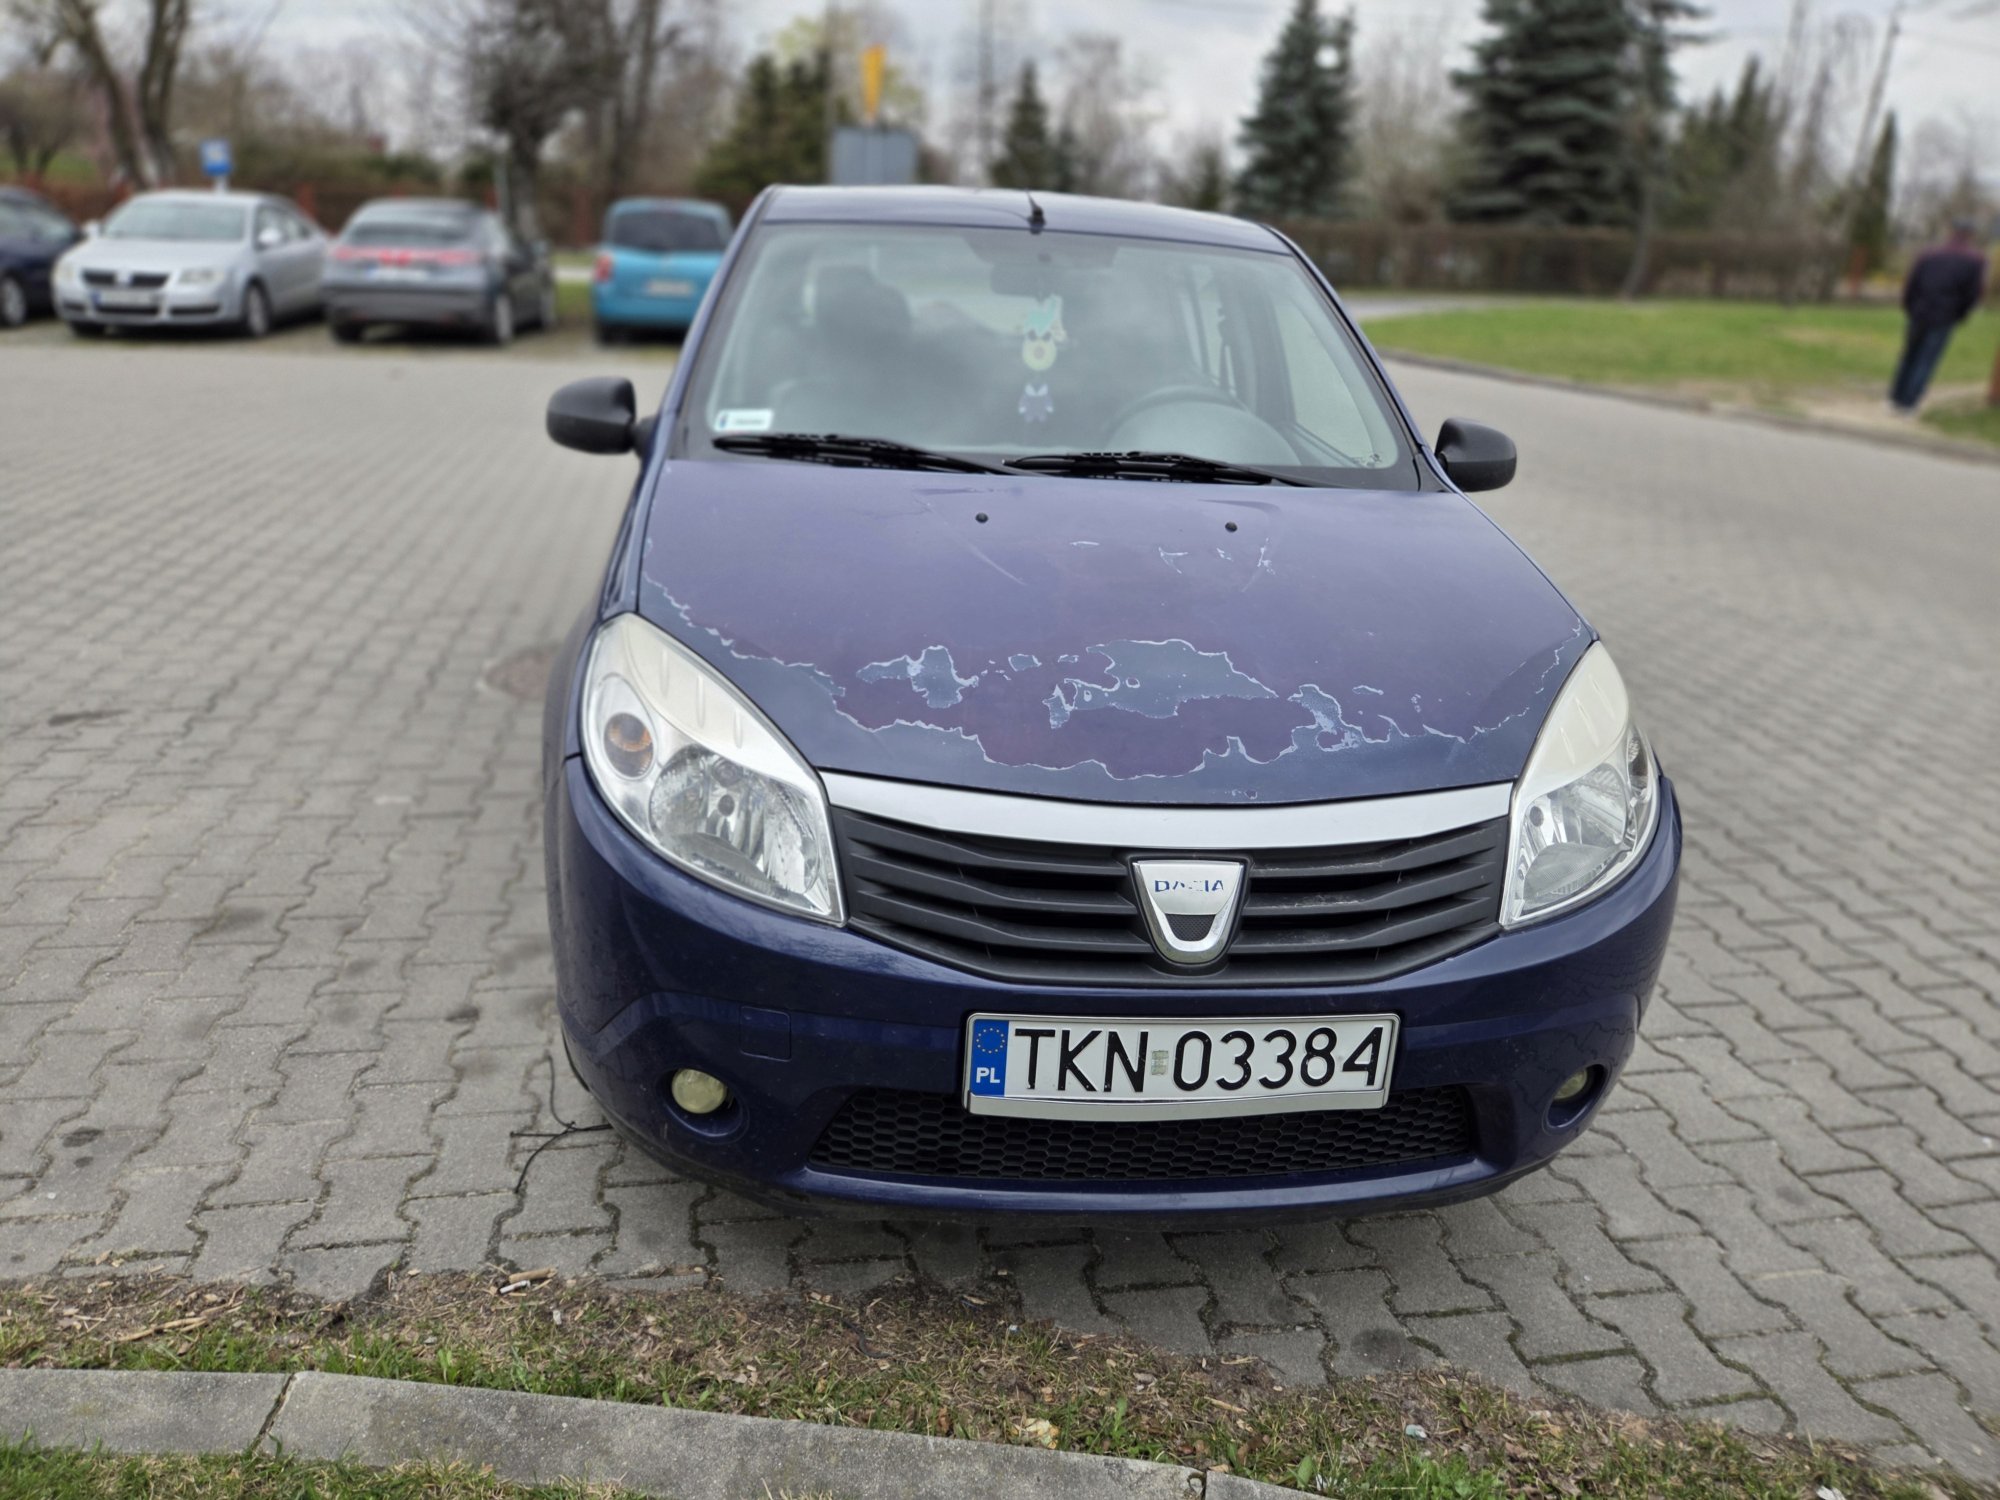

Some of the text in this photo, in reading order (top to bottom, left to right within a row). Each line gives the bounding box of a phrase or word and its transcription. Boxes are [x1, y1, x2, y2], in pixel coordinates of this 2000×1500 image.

[1154, 880, 1224, 893] DAIA
[1014, 1026, 1384, 1093] TKN 03384
[975, 1066, 1001, 1084] PL
